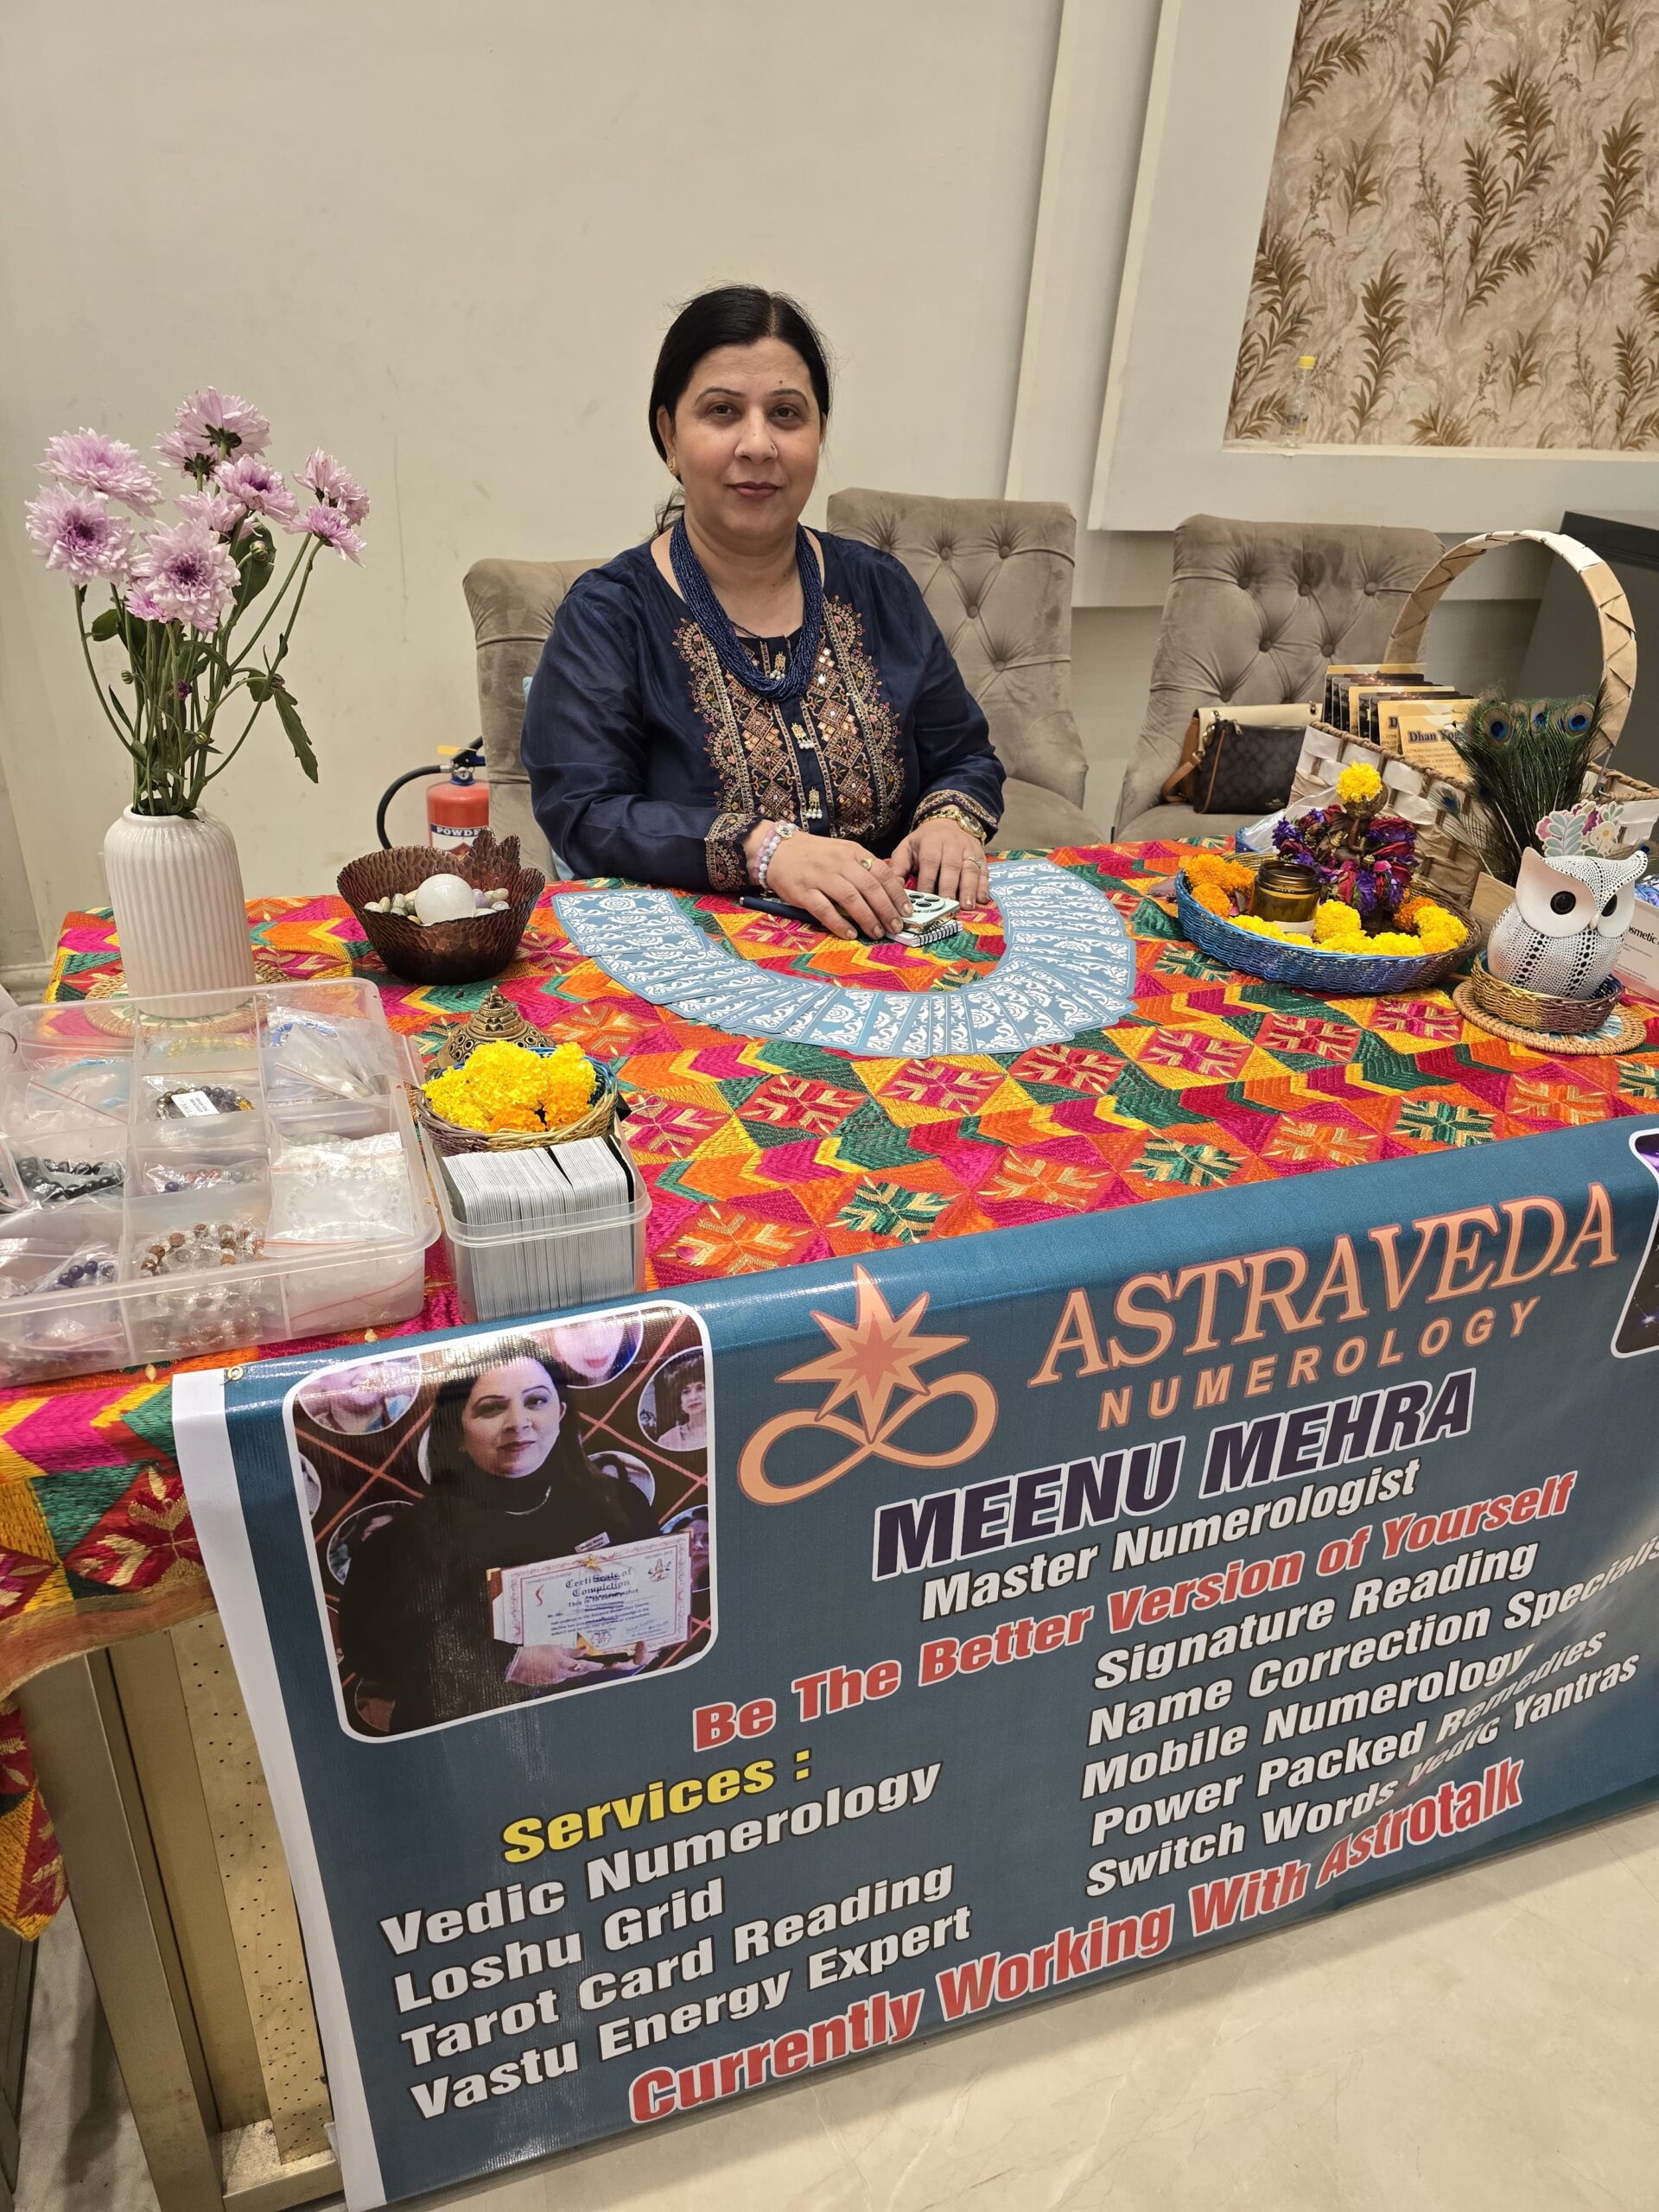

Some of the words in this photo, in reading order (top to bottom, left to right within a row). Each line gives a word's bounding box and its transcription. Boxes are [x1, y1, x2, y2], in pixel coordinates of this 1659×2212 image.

[1408, 731, 1437, 742] Dhan
[1028, 1182, 1620, 1388] ASTRAVEDA
[1097, 1297, 1541, 1432] NUMEROLOGY
[872, 1437, 1185, 1581] MEENU
[1198, 1368, 1477, 1498] MEHRA
[920, 1543, 1100, 1622] Master
[1111, 1458, 1421, 1573] Numerologist
[693, 1698, 776, 1751] Be
[791, 1660, 901, 1722] The
[918, 1606, 1095, 1687] Better
[1107, 1550, 1304, 1633] Version
[1316, 1526, 1372, 1578] of
[1381, 1471, 1578, 1559] Yourself
[1086, 1677, 1235, 1746] Name
[1248, 1605, 1492, 1700] Correction
[1092, 1598, 1334, 1690] Signature
[1349, 1541, 1539, 1622] Reading
[500, 1759, 777, 1865] Services
[1081, 1723, 1249, 1799] Mobile
[1262, 1643, 1535, 1747] Numerology
[1085, 1822, 1247, 1897] Switch
[1262, 1777, 1400, 1847] Words
[1408, 1716, 1501, 1787] Vedic
[1514, 1654, 1640, 1731] Yantras
[1090, 1775, 1244, 1847] Power
[1256, 1719, 1427, 1798] Packed
[1435, 1630, 1608, 1744] Remedies
[379, 1880, 568, 1956] Vedic
[586, 1762, 943, 1901] Numerology
[393, 1932, 583, 2014] Loshu
[602, 1877, 724, 1952] Grid
[627, 1988, 925, 2124] Currently
[934, 1903, 1173, 2022] Working
[1188, 1859, 1310, 1937] With
[1316, 1756, 1524, 1890] Astrotalk
[401, 1986, 558, 2067] Tarot
[578, 1939, 715, 2012] Card
[734, 1864, 954, 1965] Reading
[410, 2039, 578, 2121] Vastu
[599, 1971, 791, 2061] Energy
[809, 1904, 971, 1990] Expert
